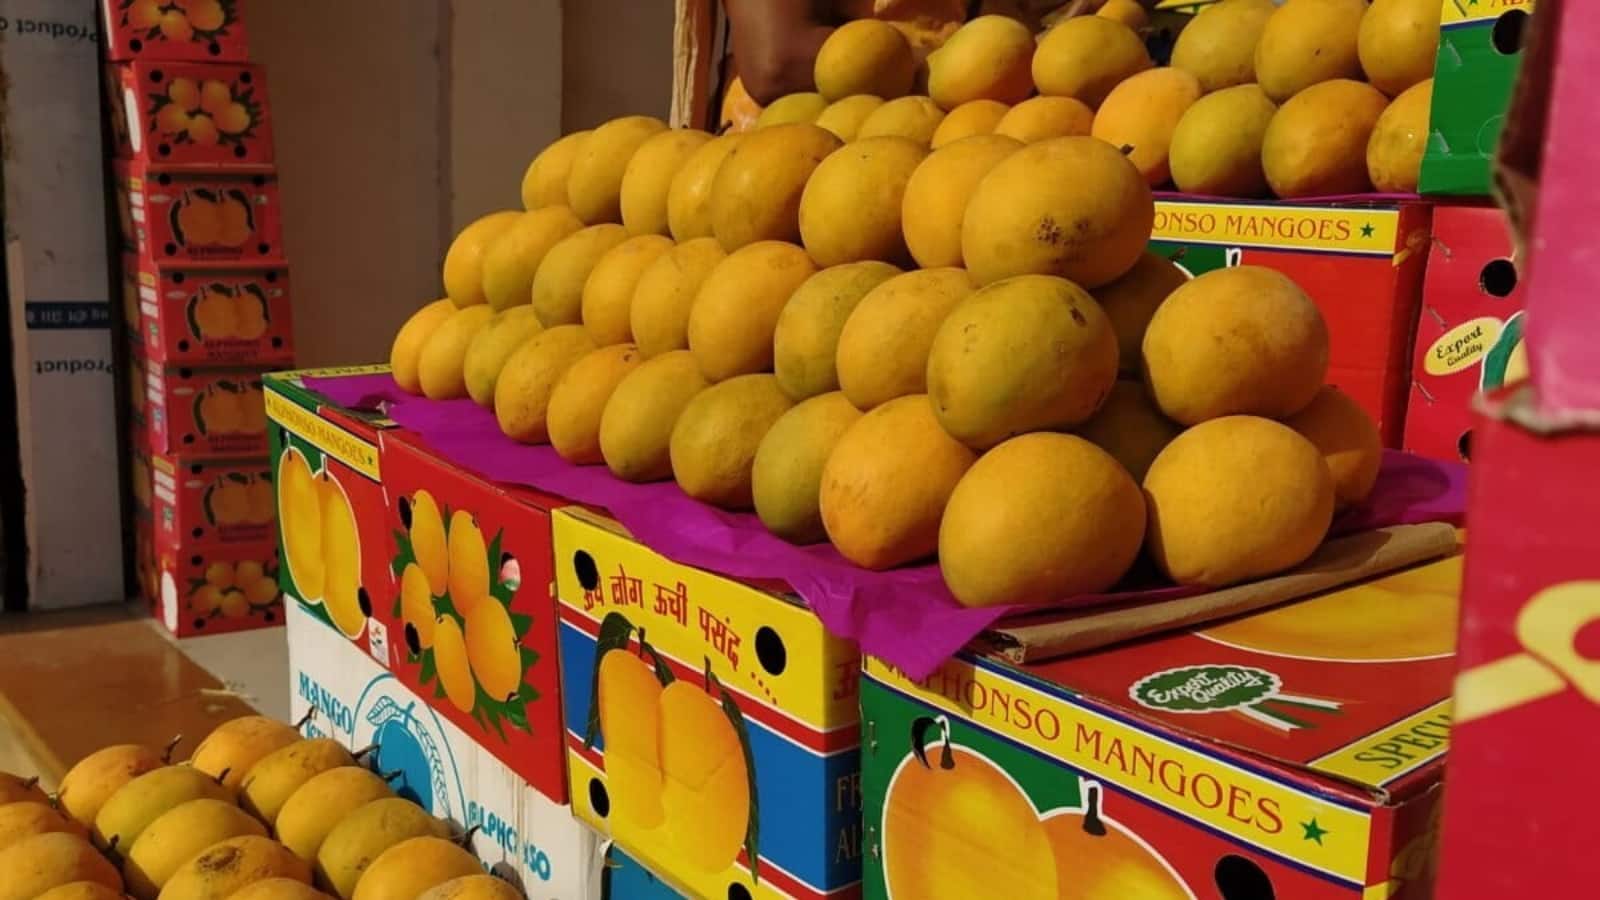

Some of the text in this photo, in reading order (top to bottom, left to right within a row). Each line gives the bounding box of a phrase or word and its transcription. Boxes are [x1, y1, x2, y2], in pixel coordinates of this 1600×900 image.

[1225, 215, 1351, 241] MANGOES
[1436, 325, 1483, 359] Export
[609, 563, 644, 608] लोग
[698, 605, 742, 671] पसंद
[299, 671, 353, 735] MANGO
[1146, 671, 1211, 703] Export
[1191, 671, 1264, 703] Quality
[1076, 723, 1283, 834] MANGOES
